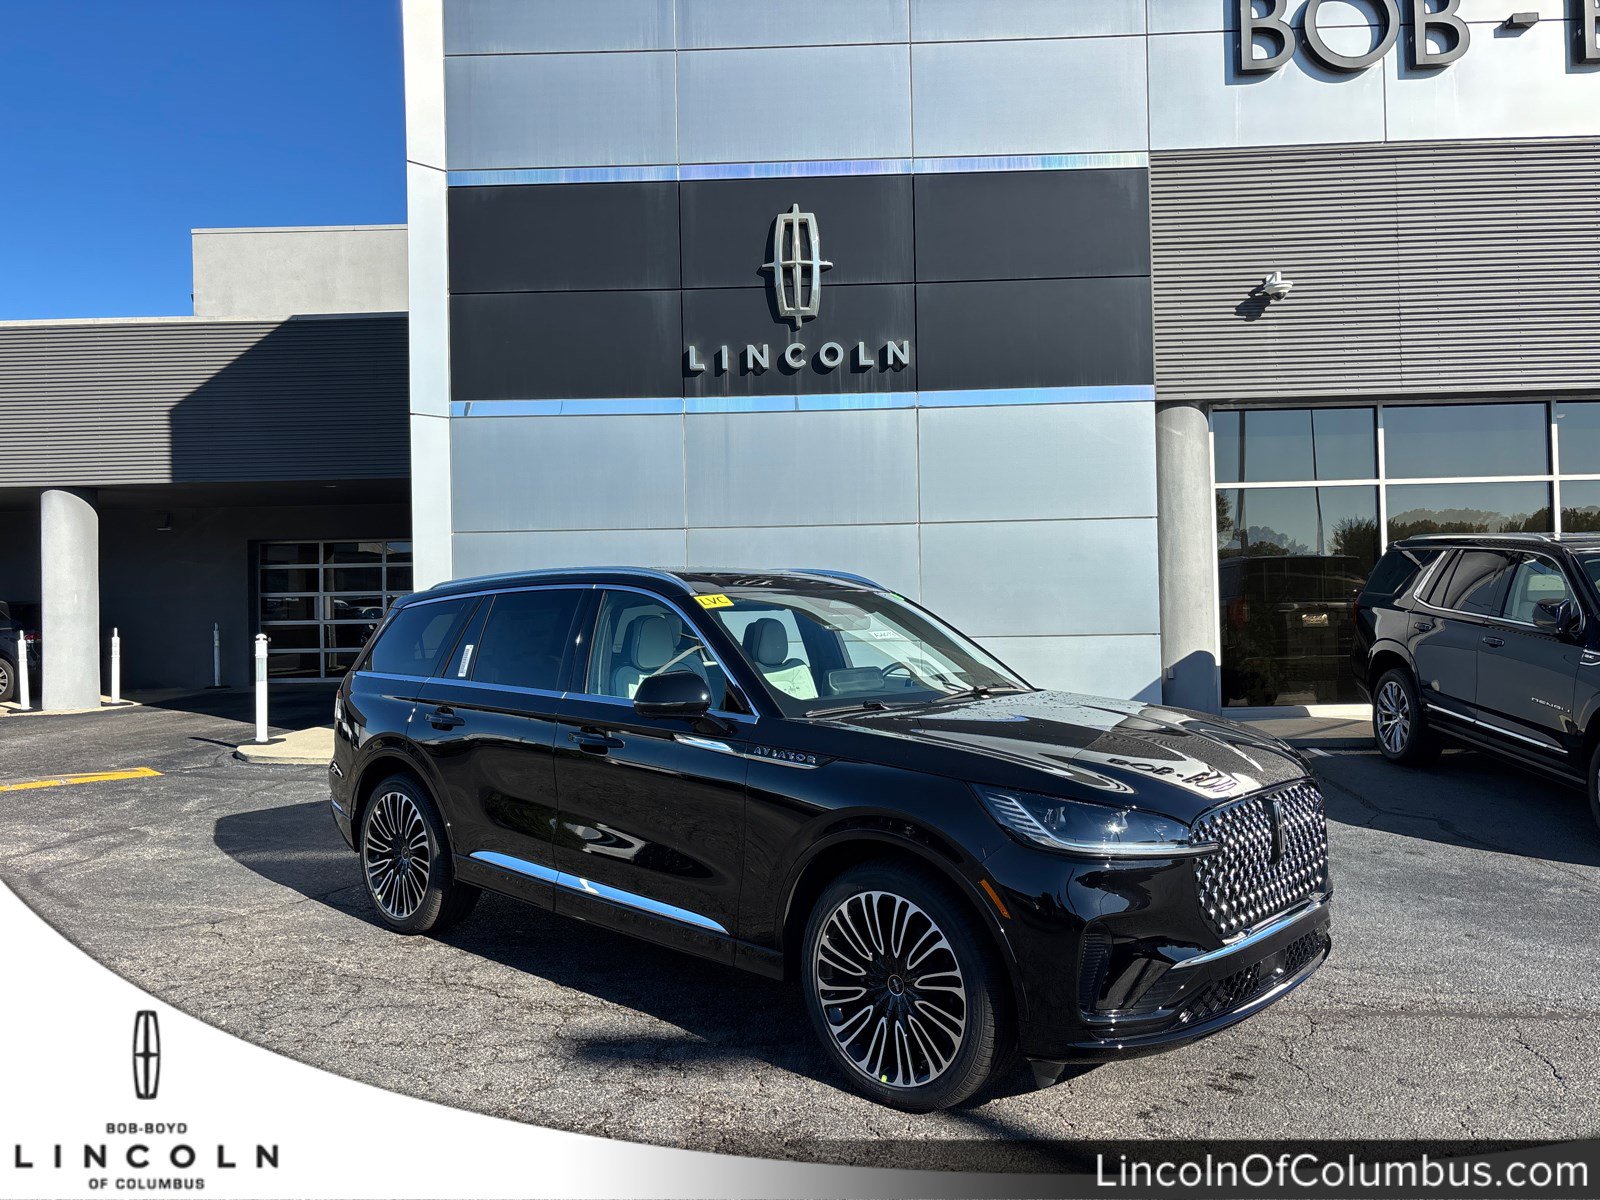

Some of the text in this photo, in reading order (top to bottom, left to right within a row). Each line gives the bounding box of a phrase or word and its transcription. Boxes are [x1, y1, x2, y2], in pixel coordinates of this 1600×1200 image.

[688, 340, 910, 371] LINCOLN
[698, 596, 729, 606] LVC
[753, 746, 816, 764] AVIATOR
